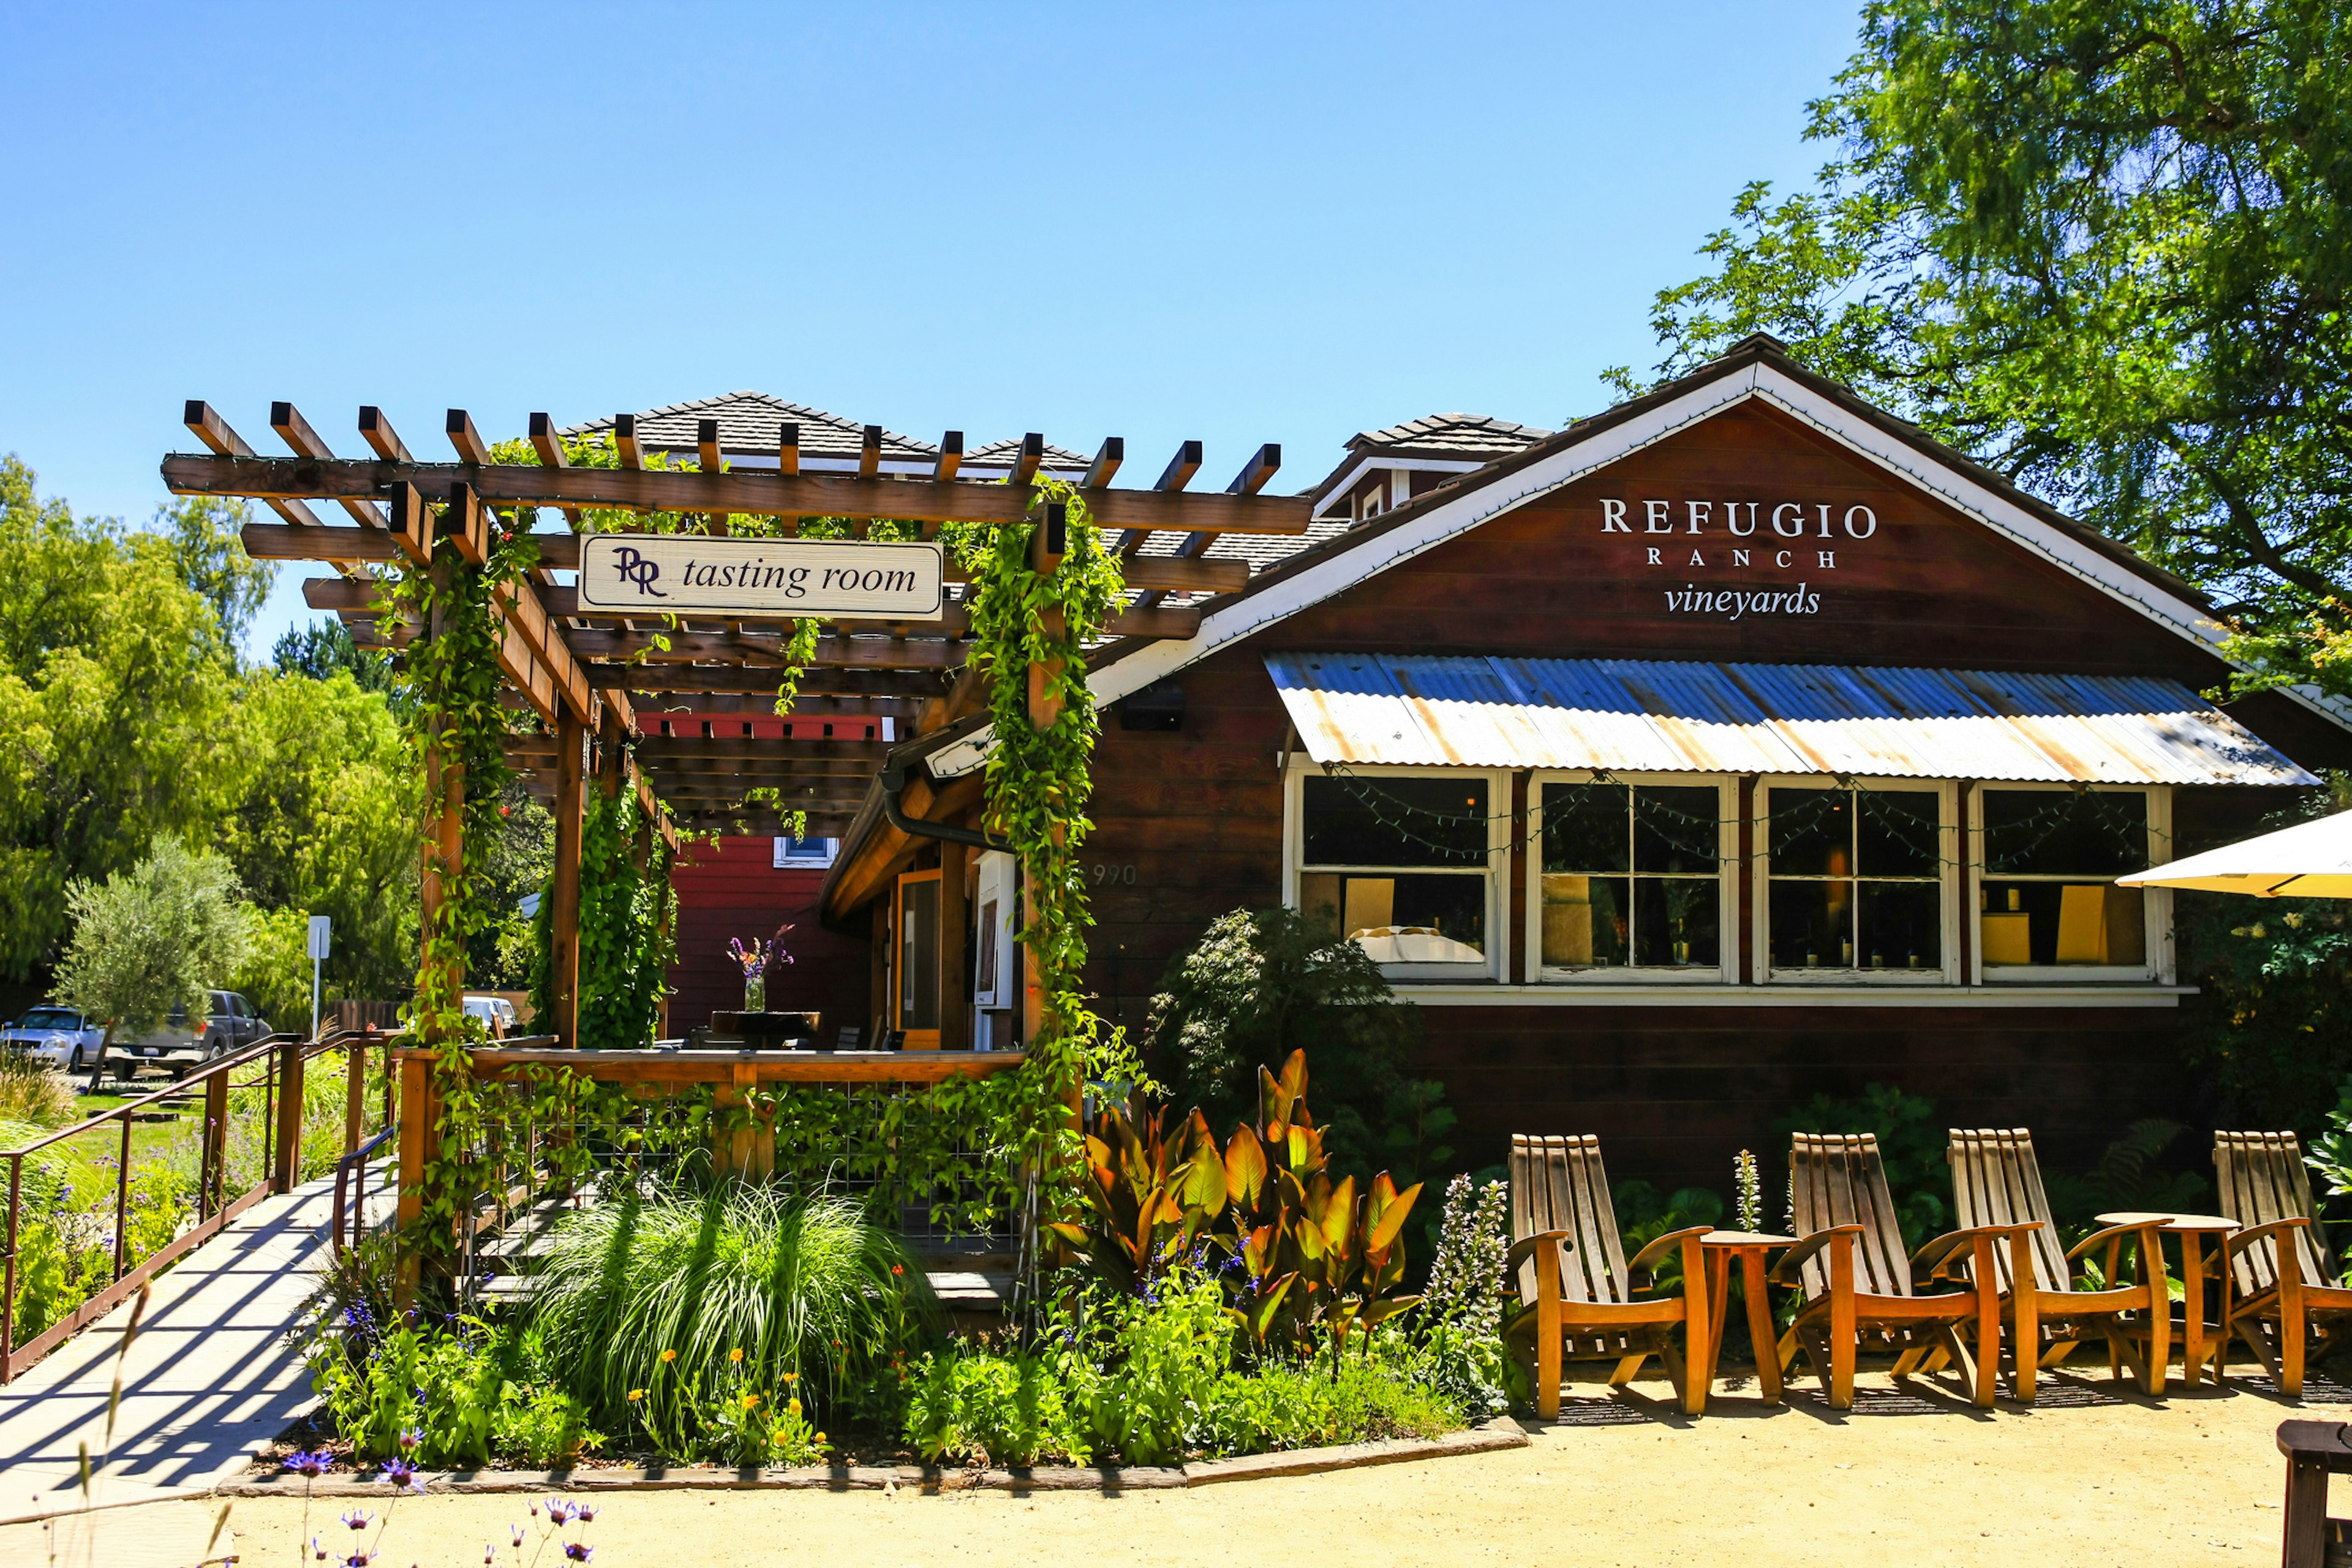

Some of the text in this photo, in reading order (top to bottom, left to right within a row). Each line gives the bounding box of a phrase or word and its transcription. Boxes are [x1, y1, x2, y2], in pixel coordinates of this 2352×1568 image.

[1599, 498, 1877, 539] REFUGIO
[1646, 547, 1836, 568] RANCH
[683, 558, 810, 598] tasting
[823, 567, 916, 592] room
[1664, 582, 1820, 621] vineyards
